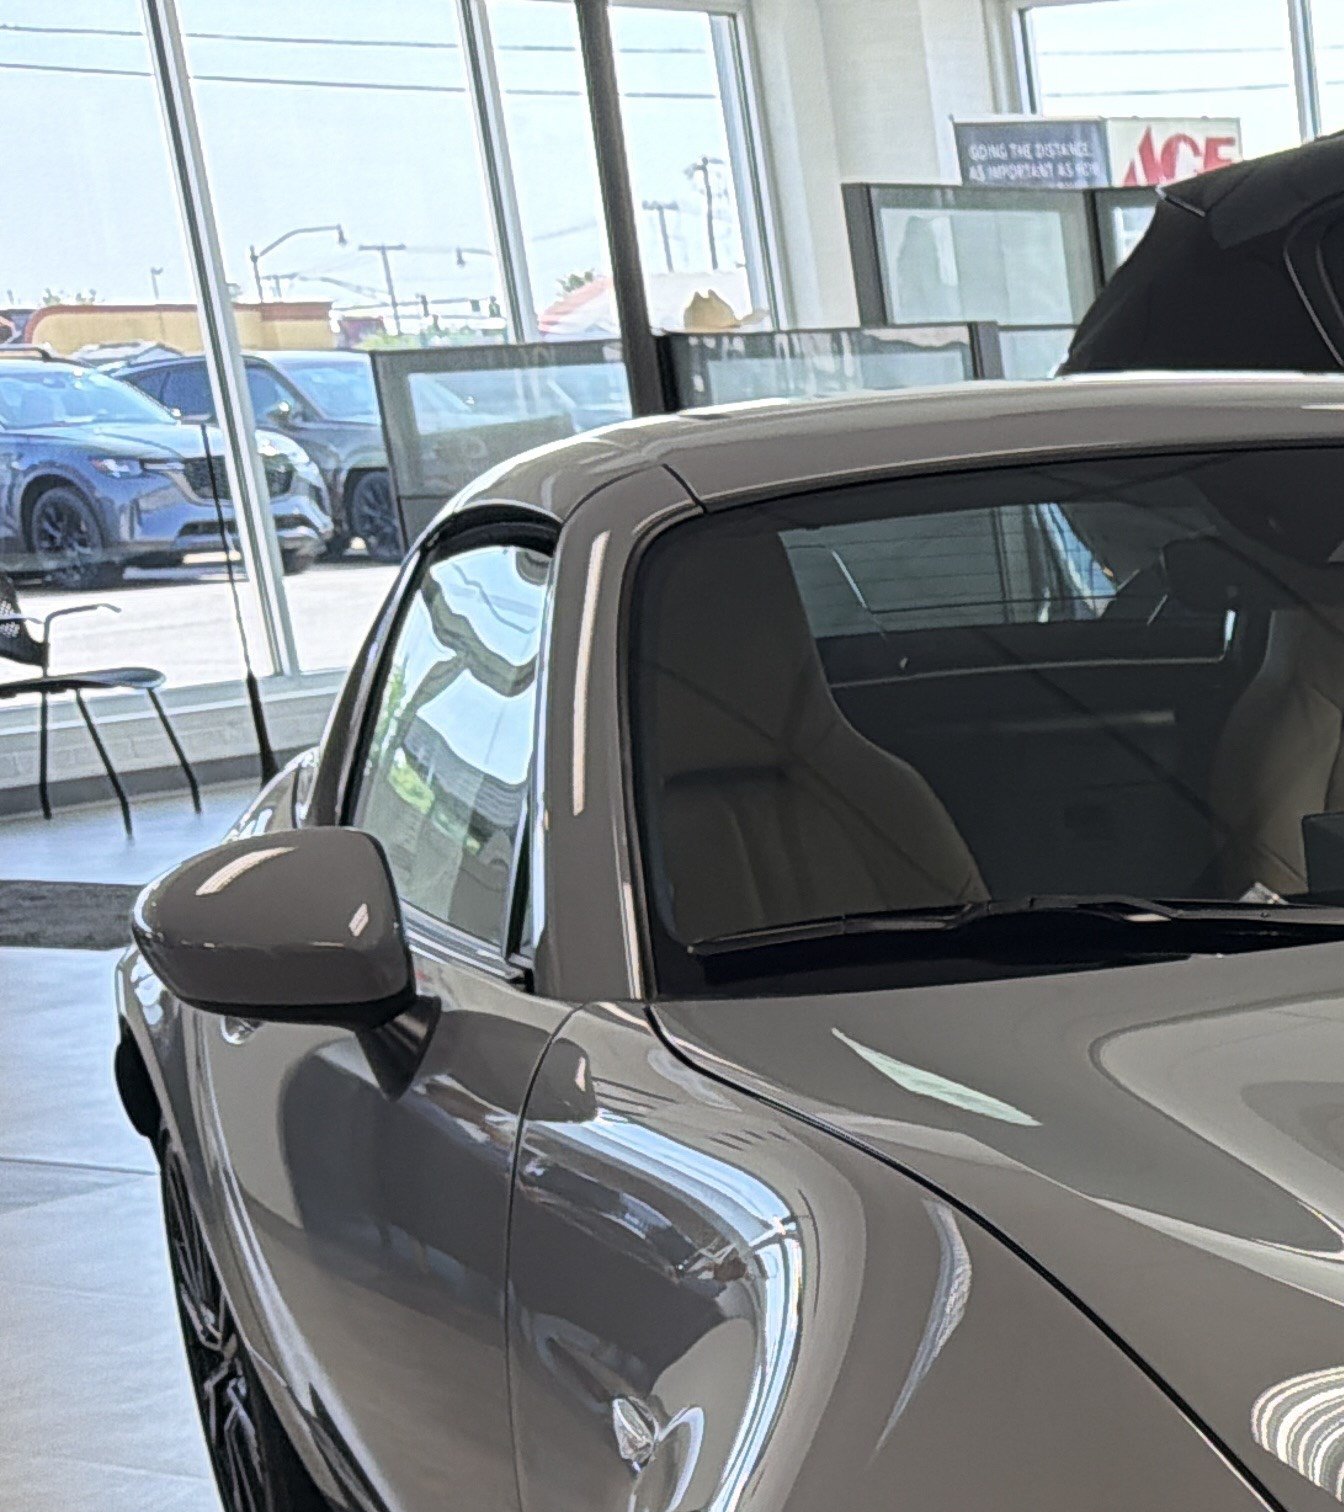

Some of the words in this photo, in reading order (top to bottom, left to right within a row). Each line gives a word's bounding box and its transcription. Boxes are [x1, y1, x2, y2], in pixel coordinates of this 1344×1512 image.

[968, 142, 1008, 160] GOING
[1009, 142, 1033, 160] THE
[1122, 124, 1236, 186] ACE
